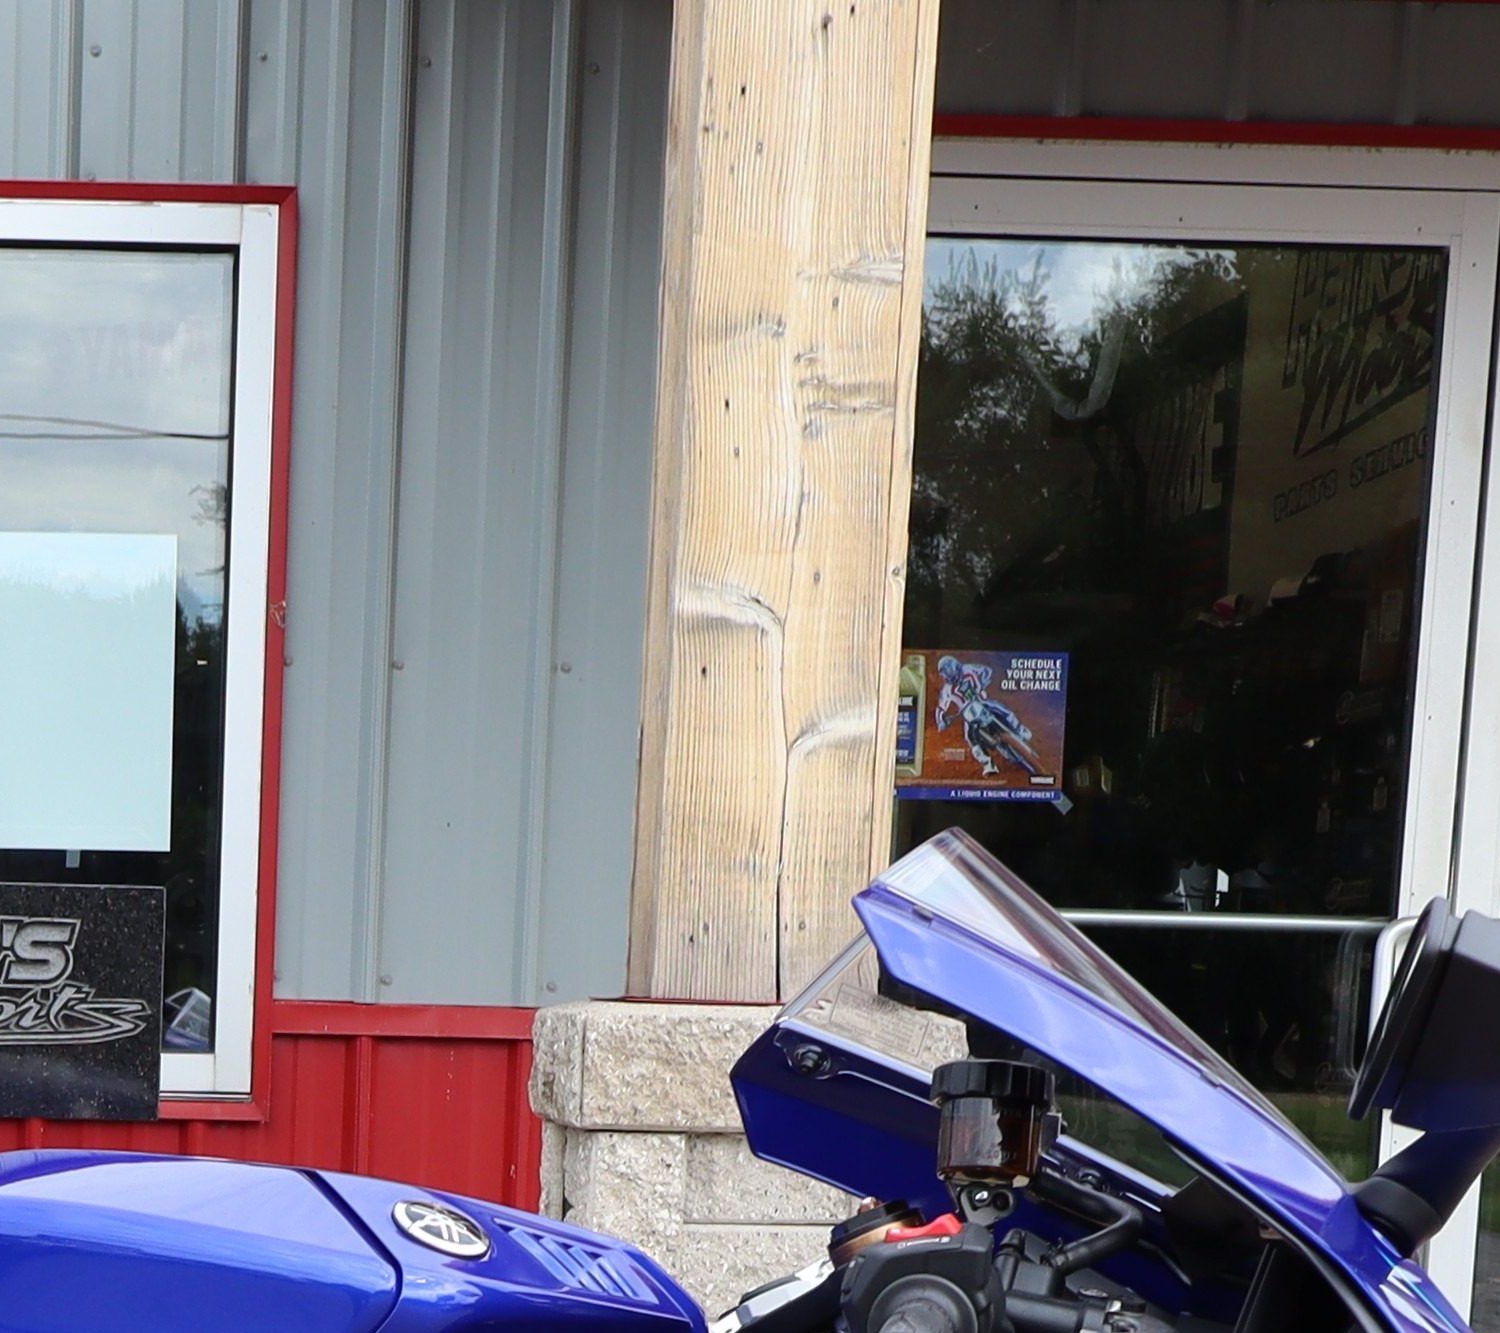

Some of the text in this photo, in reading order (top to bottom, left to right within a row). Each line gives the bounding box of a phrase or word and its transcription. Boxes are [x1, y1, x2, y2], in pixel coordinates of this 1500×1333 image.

[1011, 658, 1062, 669] SCHEDULE
[1006, 670, 1061, 680] YOUR NEXT
[1001, 680, 1061, 691] OIL CHANGE
